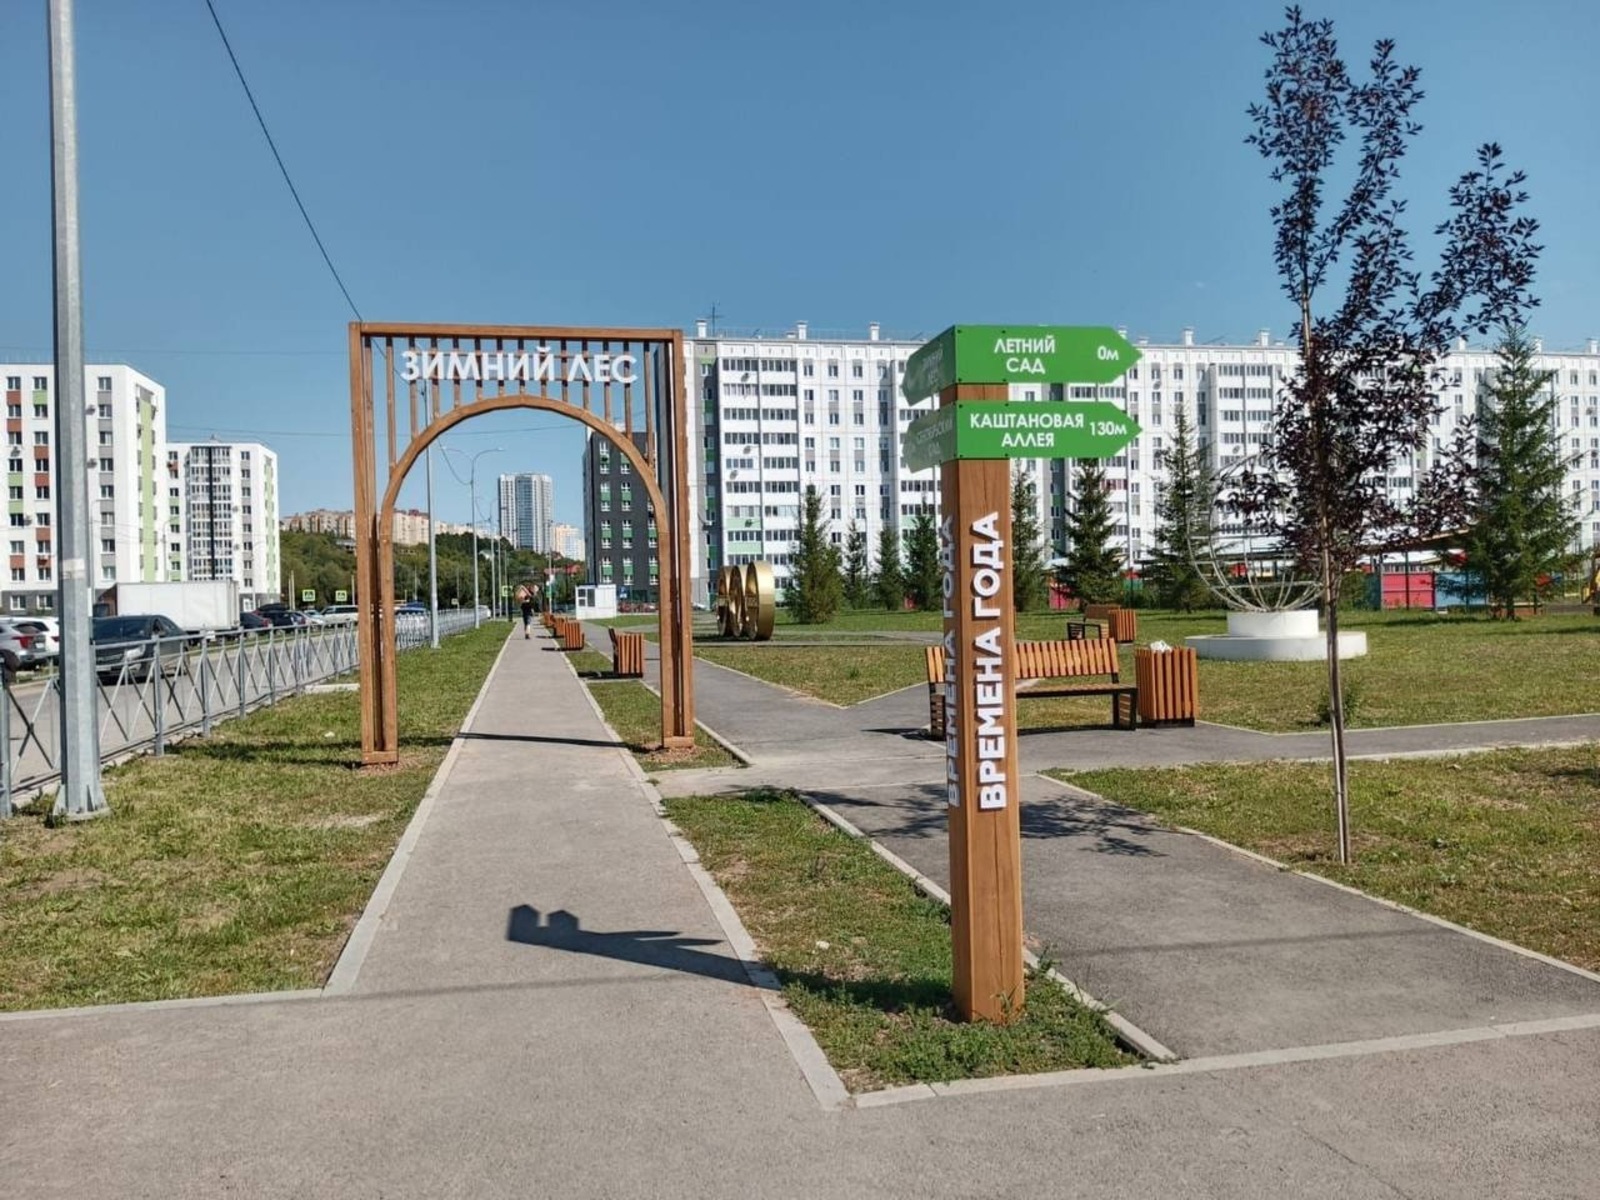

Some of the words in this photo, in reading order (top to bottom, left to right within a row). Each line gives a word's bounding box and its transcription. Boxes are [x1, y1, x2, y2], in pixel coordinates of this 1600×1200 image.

[994, 335, 1055, 354] ЛЕТНИЙ
[401, 346, 555, 382] ЗИМНИЙ
[567, 354, 638, 383] ЛЕС
[1006, 357, 1046, 374] САД
[970, 413, 1084, 429] КАШТАНОВАЯ
[1001, 432, 1055, 447] АЛЛЕЯ
[972, 511, 1004, 618] ГОДА
[974, 626, 1007, 809] ВРЕМЕНА
